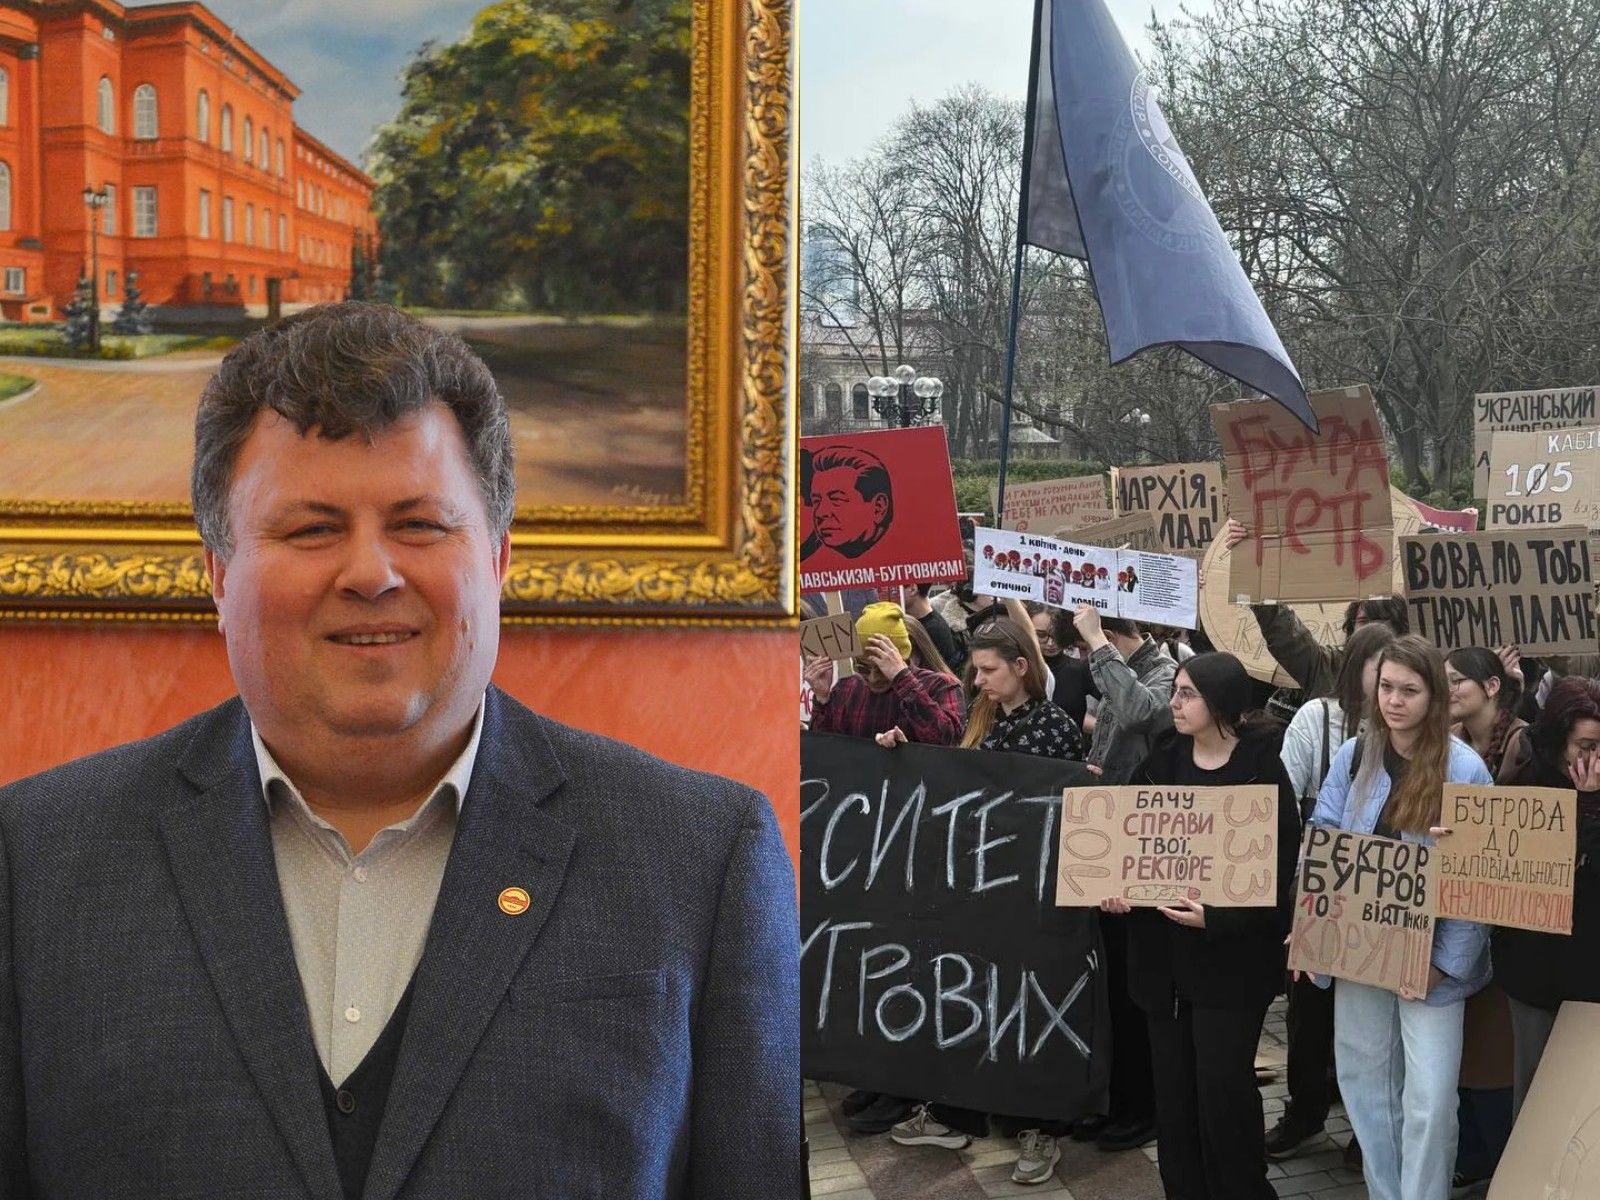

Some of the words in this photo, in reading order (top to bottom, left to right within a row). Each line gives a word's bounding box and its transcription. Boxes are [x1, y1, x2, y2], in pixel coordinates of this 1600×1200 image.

[1478, 389, 1595, 422] УКРАЇНСЬКИЙ
[1504, 461, 1574, 497] 105
[1492, 503, 1561, 524] РОКІВ
[1020, 536, 1026, 545] 1
[1029, 538, 1057, 551] квітня
[1063, 545, 1085, 557] день
[1406, 540, 1492, 592] ВОВА,
[1492, 541, 1521, 584] ПО
[1527, 539, 1590, 584] ТОБІ
[990, 580, 1031, 593] етичної
[1409, 595, 1502, 648] ТЮРМА
[1510, 591, 1596, 645] ПЛАЧЕ
[1136, 791, 1195, 809] БАЧУ
[1454, 796, 1565, 831] БУГРОВА
[1123, 812, 1214, 836] СПРАВИ
[1138, 836, 1192, 856] ТВОЇ,
[1305, 827, 1429, 874] РЕКТОР
[1482, 830, 1519, 857] ДО
[1121, 855, 1214, 881] РЕКТОРЕ
[1303, 859, 1426, 907] БУГРОВ
[1300, 893, 1347, 919] 105
[1440, 879, 1473, 916] КНУ
